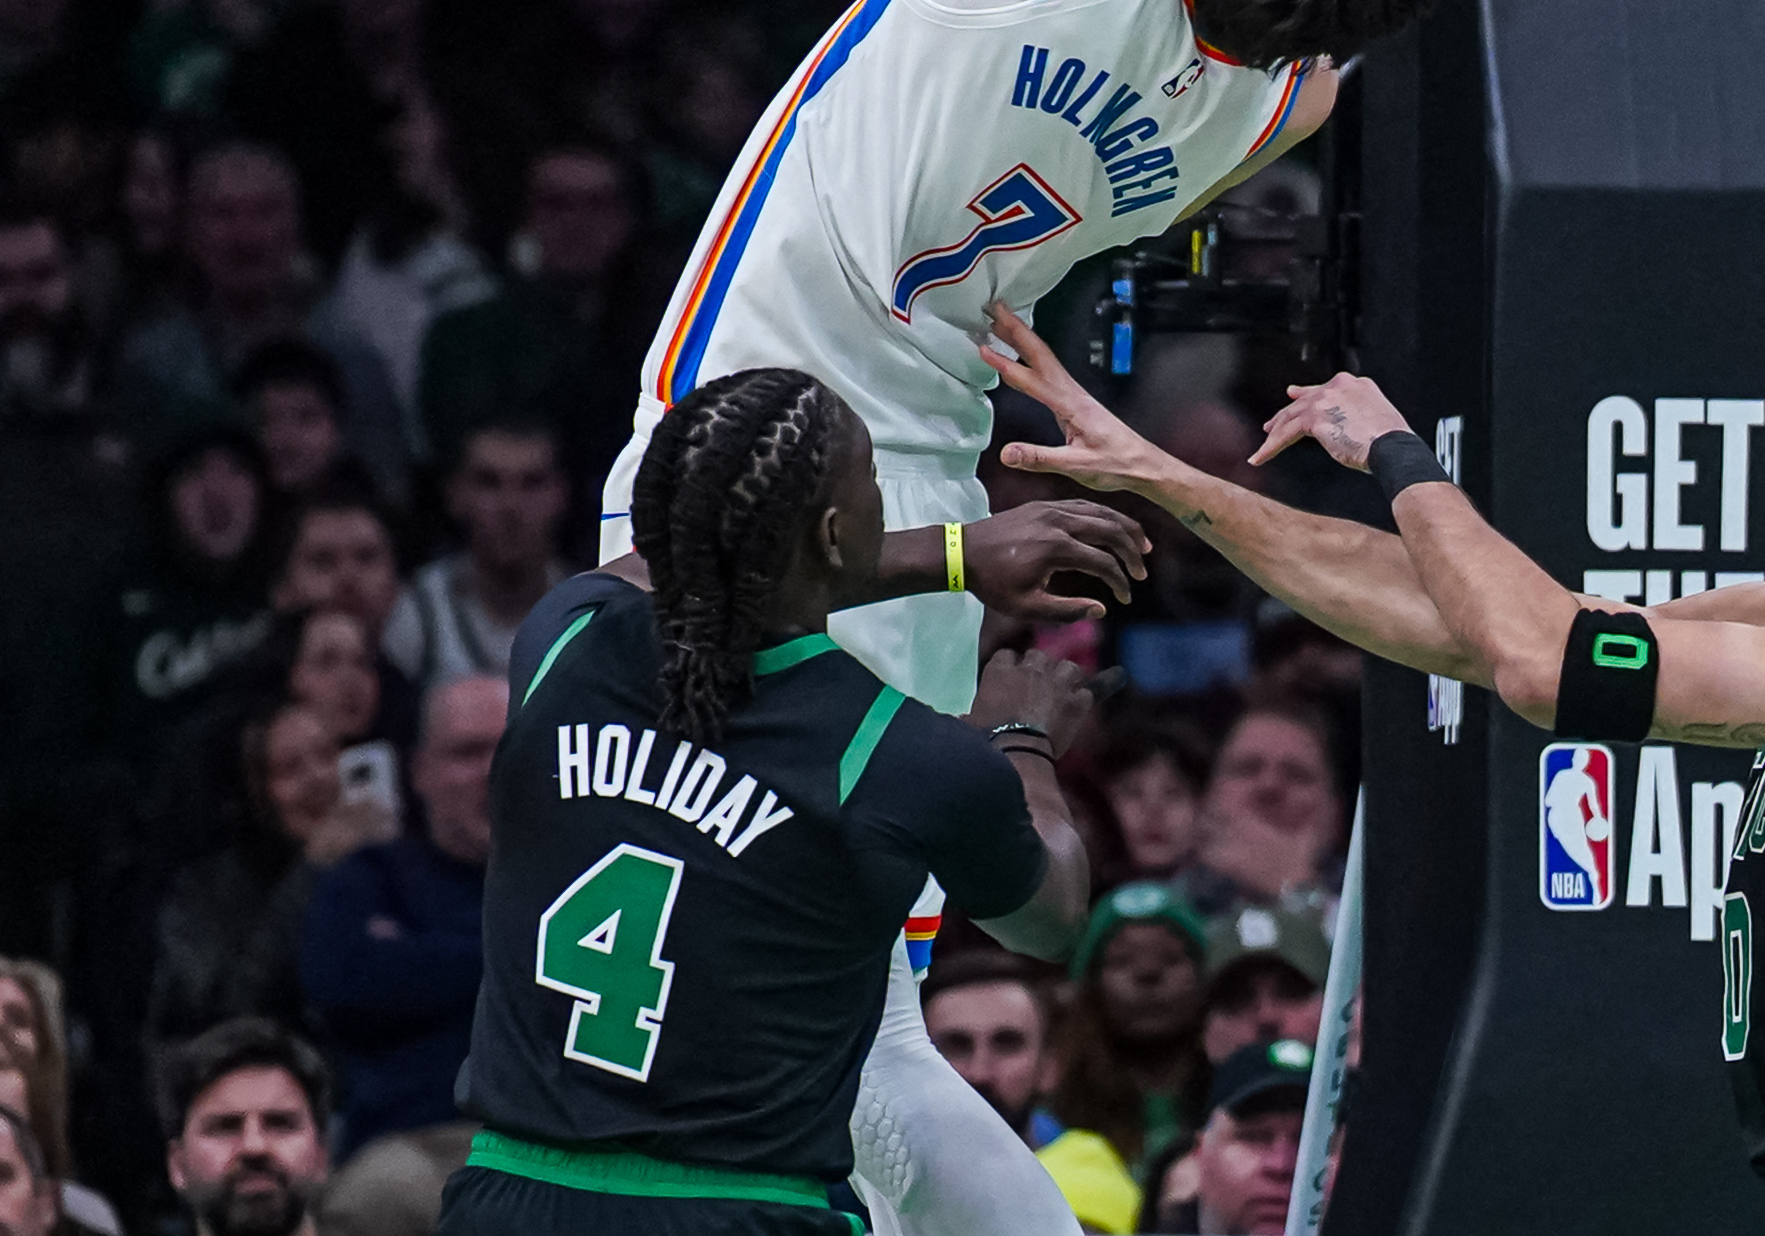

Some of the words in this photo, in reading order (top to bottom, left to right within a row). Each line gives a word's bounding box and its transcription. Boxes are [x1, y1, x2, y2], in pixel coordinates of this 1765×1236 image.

[891, 162, 1084, 325] 7
[557, 722, 796, 859] HOLIDAY
[1625, 745, 1746, 942] Ap
[534, 841, 685, 1084] 4
[1550, 871, 1587, 900] NBA
[1720, 890, 1753, 1062] 0
